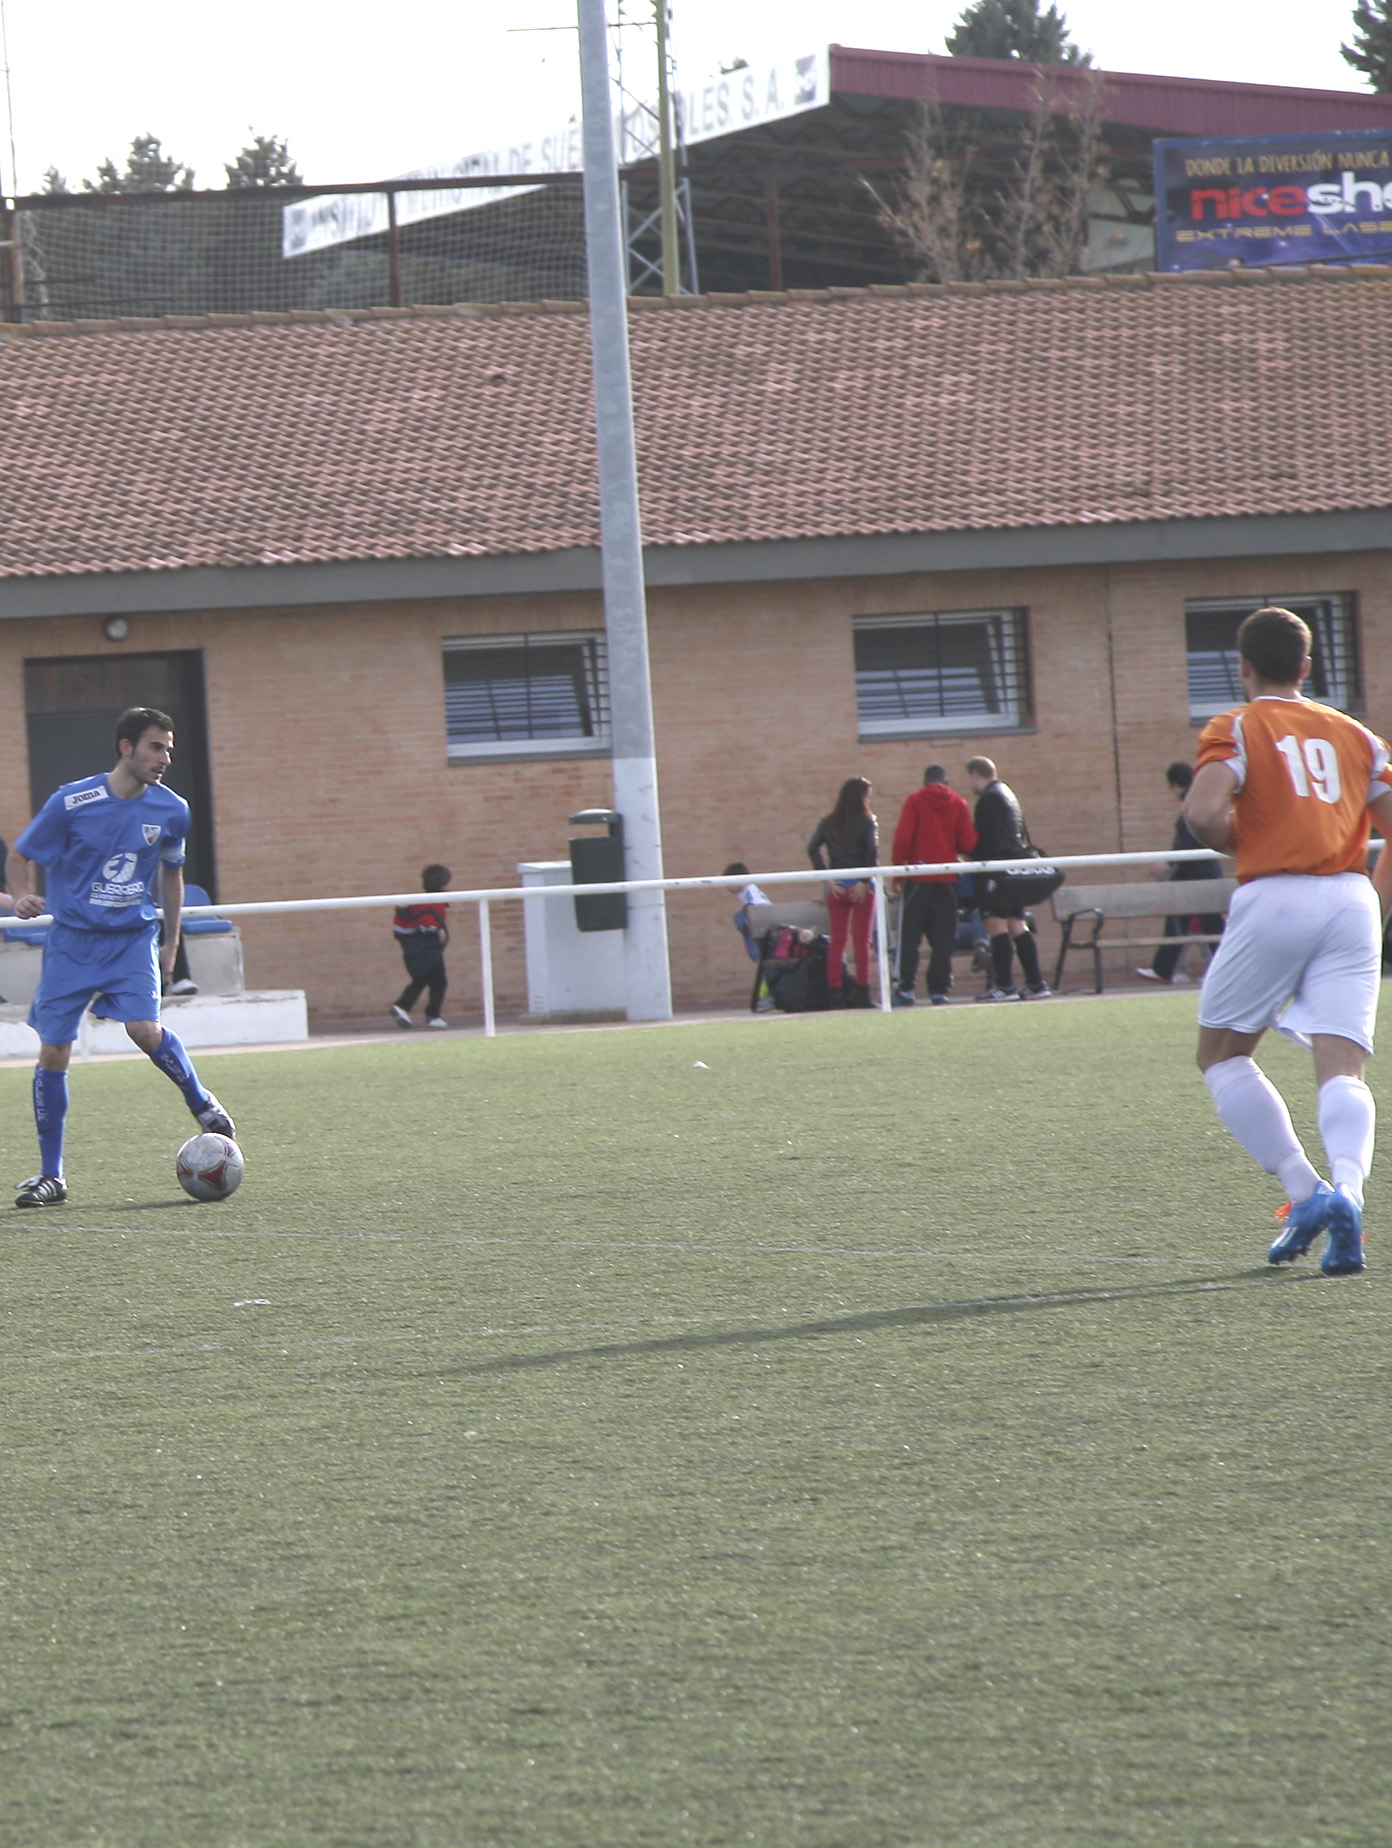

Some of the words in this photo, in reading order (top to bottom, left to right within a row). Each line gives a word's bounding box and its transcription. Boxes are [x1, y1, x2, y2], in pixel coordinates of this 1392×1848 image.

[1186, 157, 1231, 177] DONDE
[1236, 156, 1255, 175] LA
[1337, 150, 1390, 169] NUNCA
[1190, 170, 1392, 220] nicesh
[1176, 224, 1313, 242] EXTREME
[1274, 733, 1343, 805] 19
